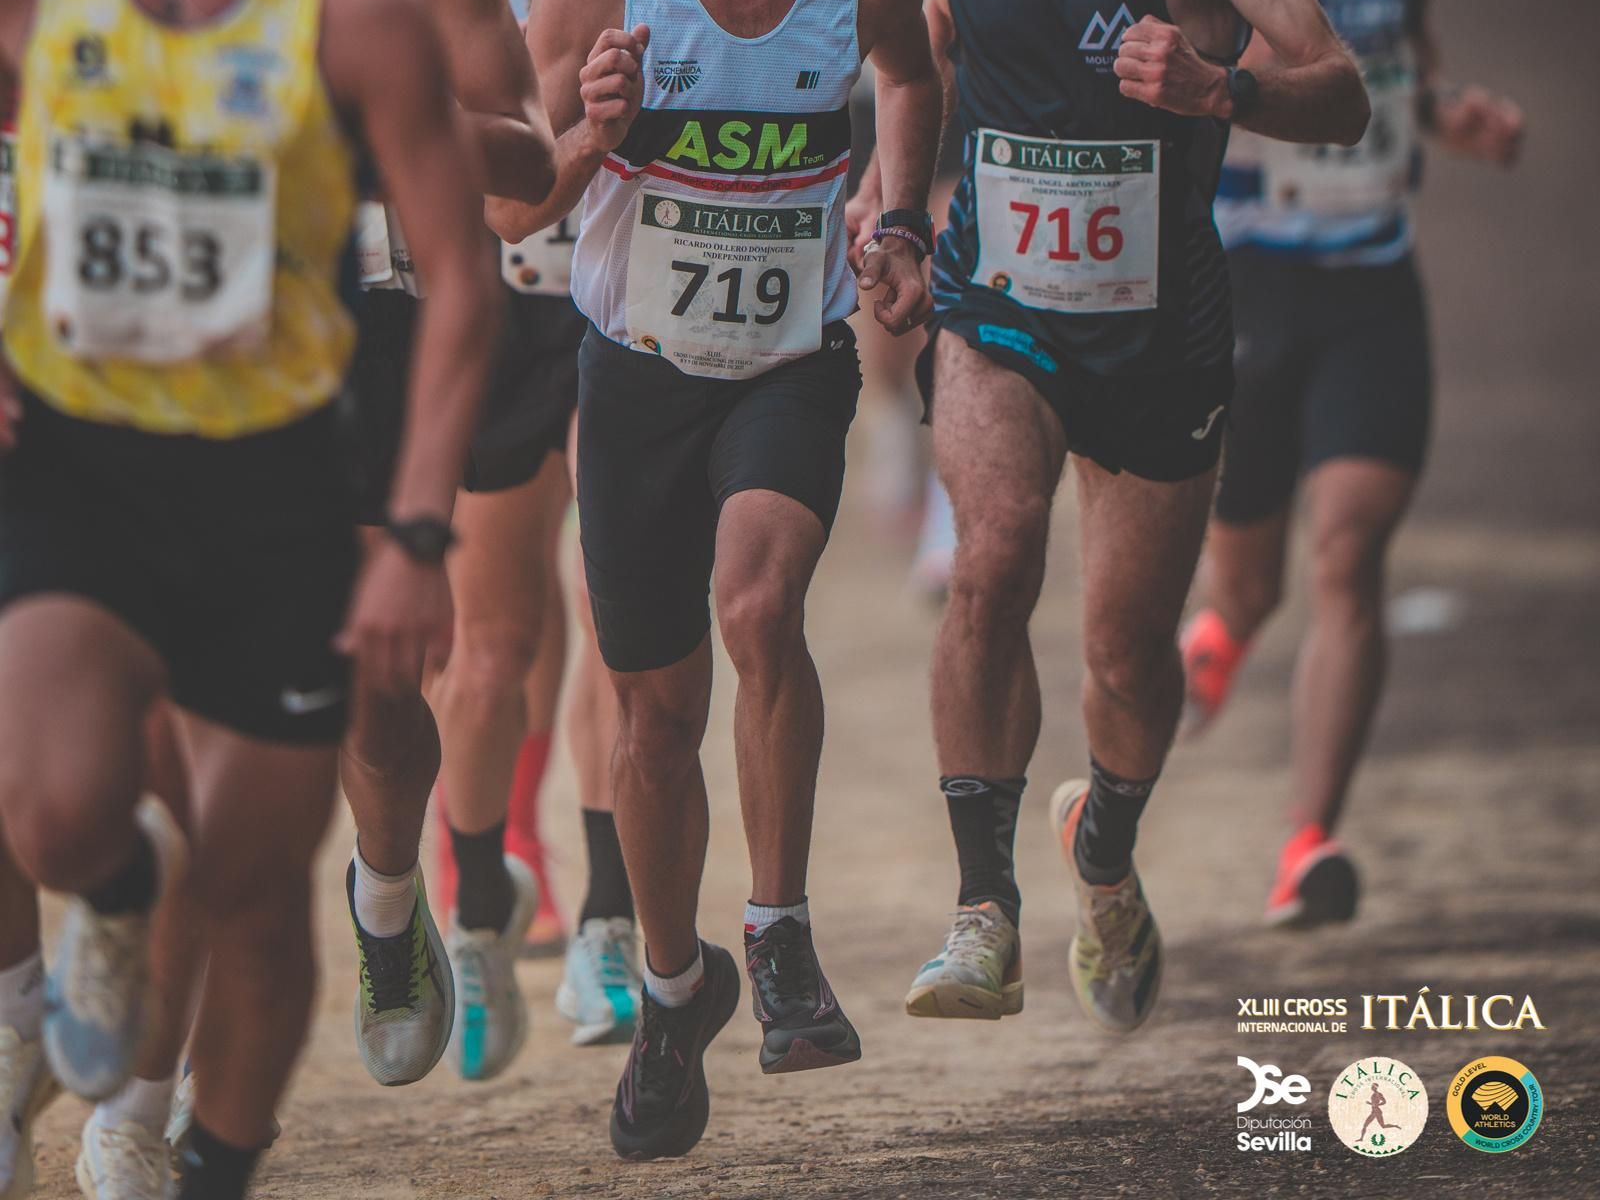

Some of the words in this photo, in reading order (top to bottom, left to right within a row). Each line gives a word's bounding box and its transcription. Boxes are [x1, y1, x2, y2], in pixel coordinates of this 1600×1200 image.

[666, 120, 807, 170] ASM
[803, 154, 824, 165] Team
[1021, 145, 1106, 169] ITÁLICA
[694, 209, 782, 233] ITÁLICA
[1009, 201, 1124, 262] 716
[79, 215, 222, 302] 853
[674, 237, 712, 250] RICARDO
[713, 243, 748, 253] OLLERO
[703, 251, 768, 263] INDEPENDIENTE
[670, 260, 791, 325] 719
